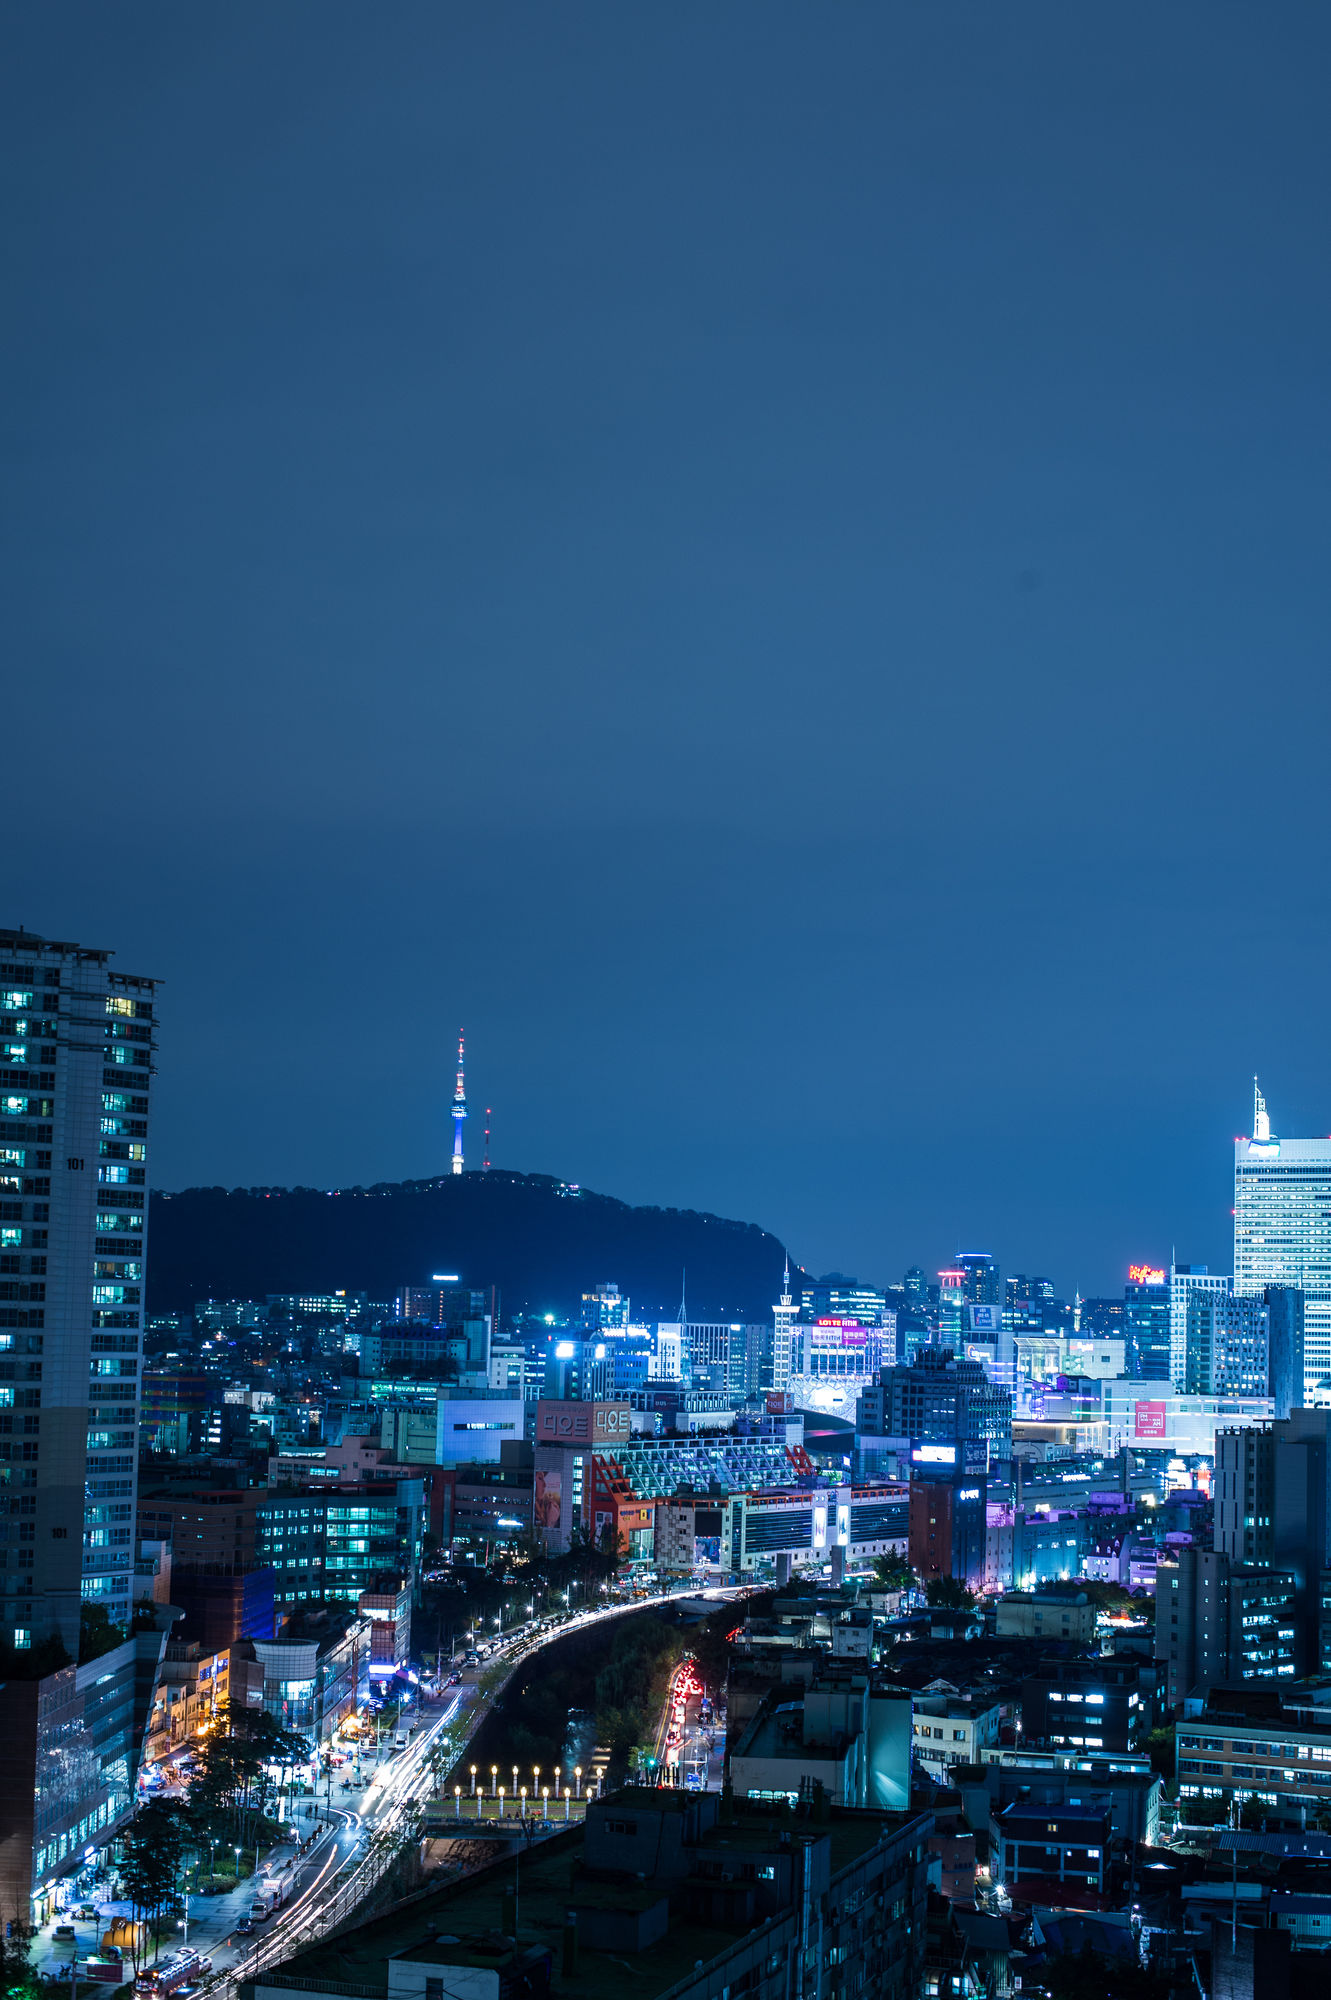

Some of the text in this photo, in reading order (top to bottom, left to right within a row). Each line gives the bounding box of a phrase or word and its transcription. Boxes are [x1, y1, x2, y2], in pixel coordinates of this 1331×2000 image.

[67, 1158, 84, 1171] 101
[543, 1415, 588, 1438] 디오트
[597, 1411, 628, 1433] 디오트
[52, 1528, 67, 1539] 101
